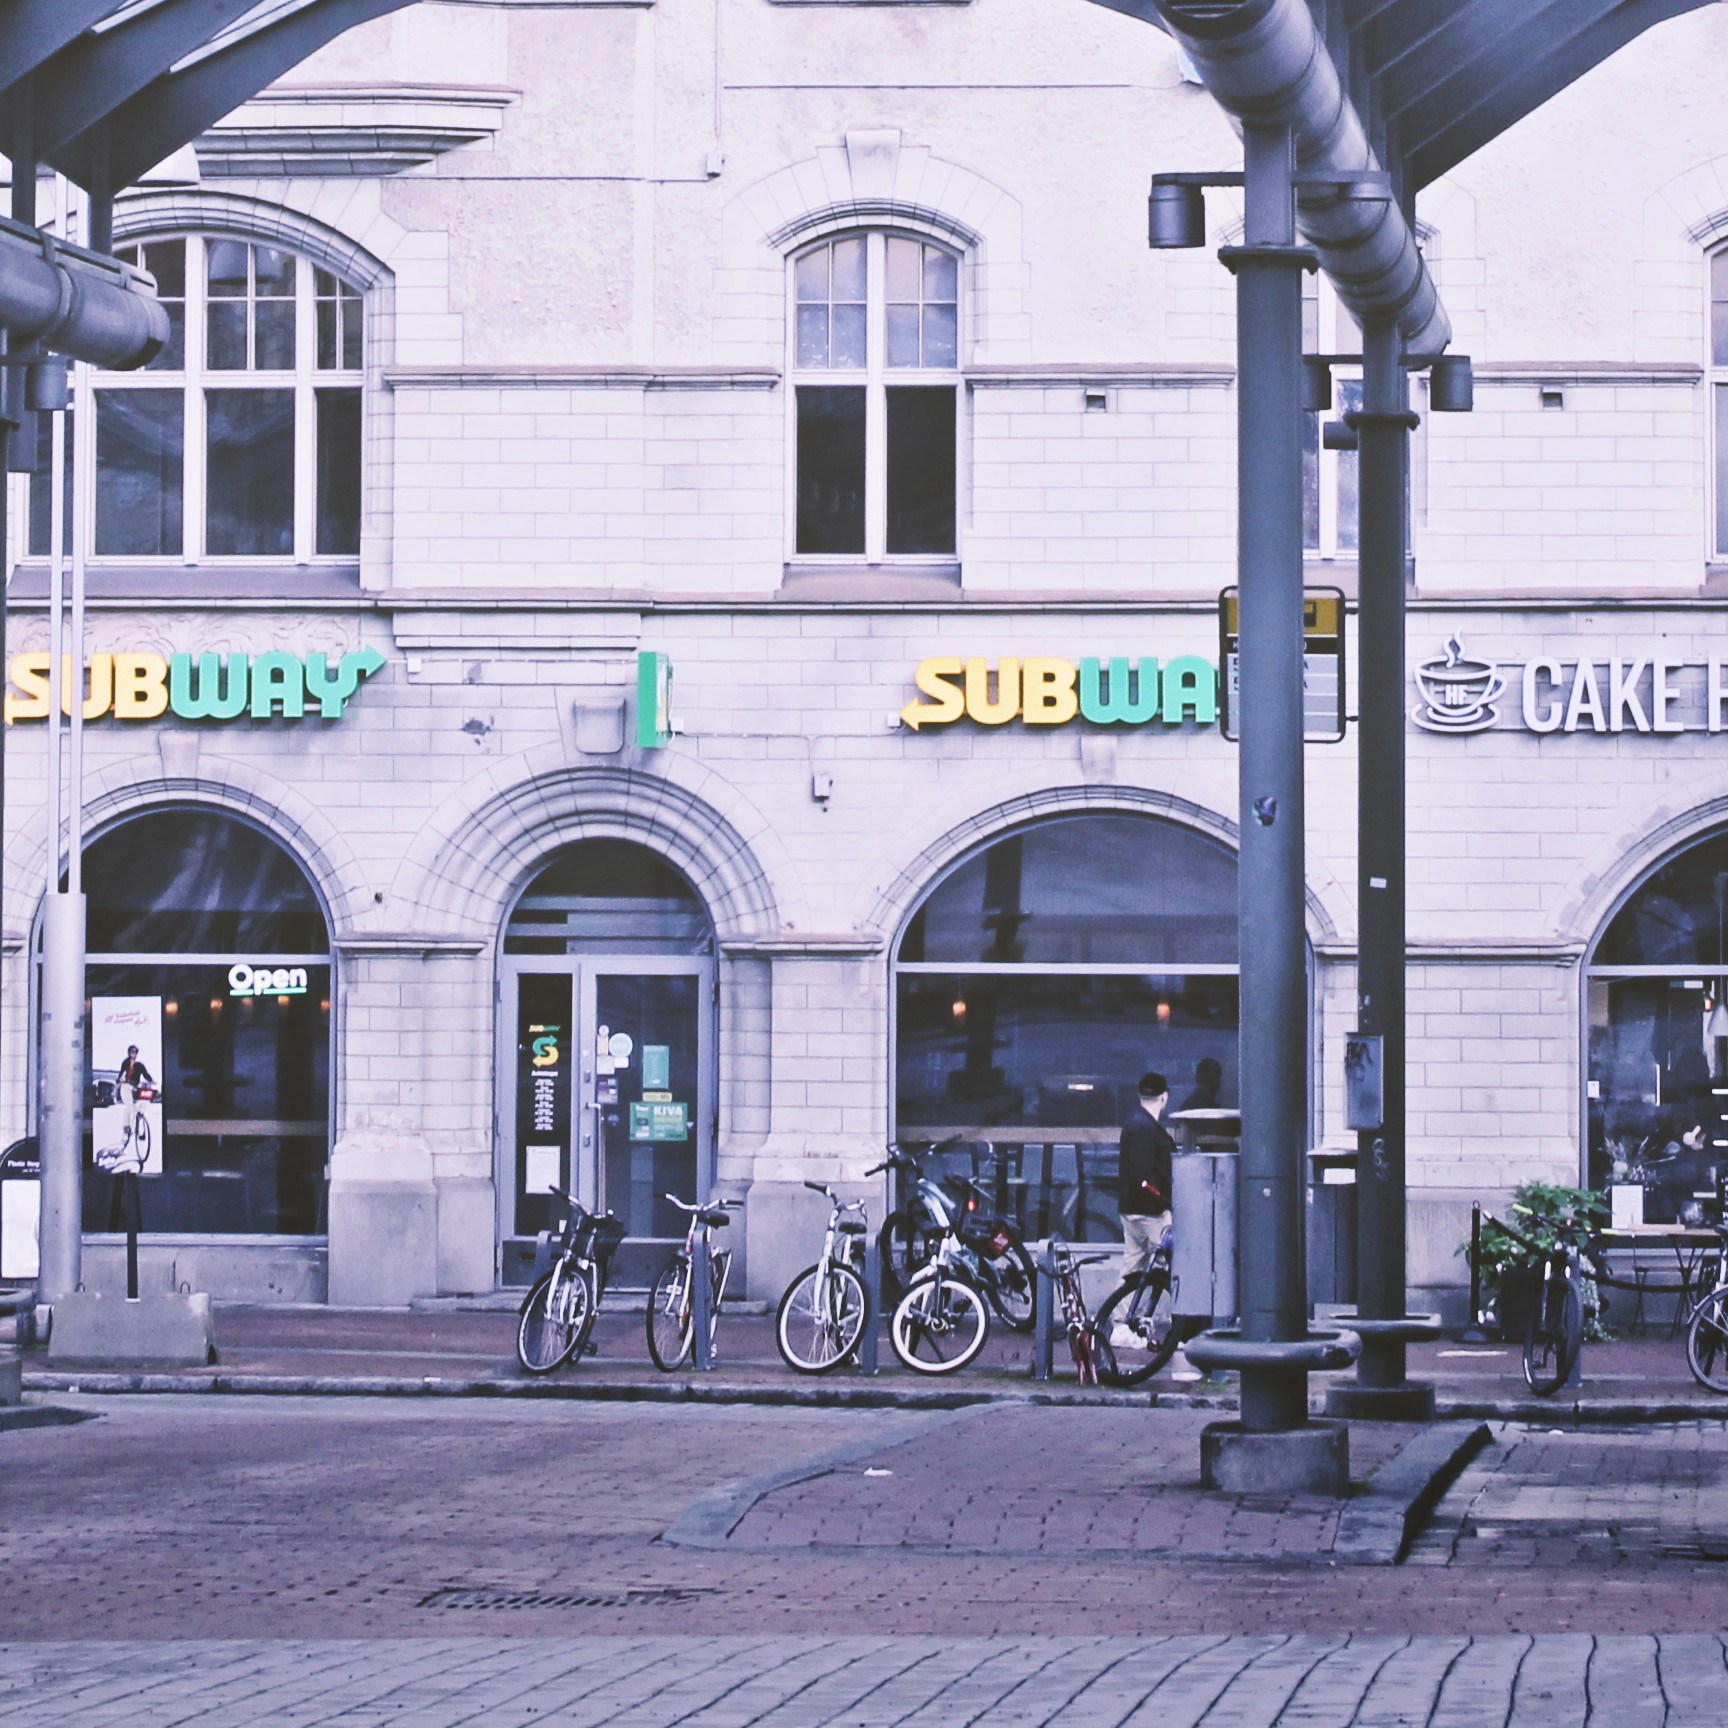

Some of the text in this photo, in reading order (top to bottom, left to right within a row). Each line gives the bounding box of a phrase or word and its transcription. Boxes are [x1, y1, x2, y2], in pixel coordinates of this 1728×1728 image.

[3, 645, 387, 726] SUBWAY
[899, 654, 1218, 731] SUBWA
[1445, 684, 1468, 705] HF
[1521, 656, 1685, 733] CAKE
[228, 963, 307, 996] Open
